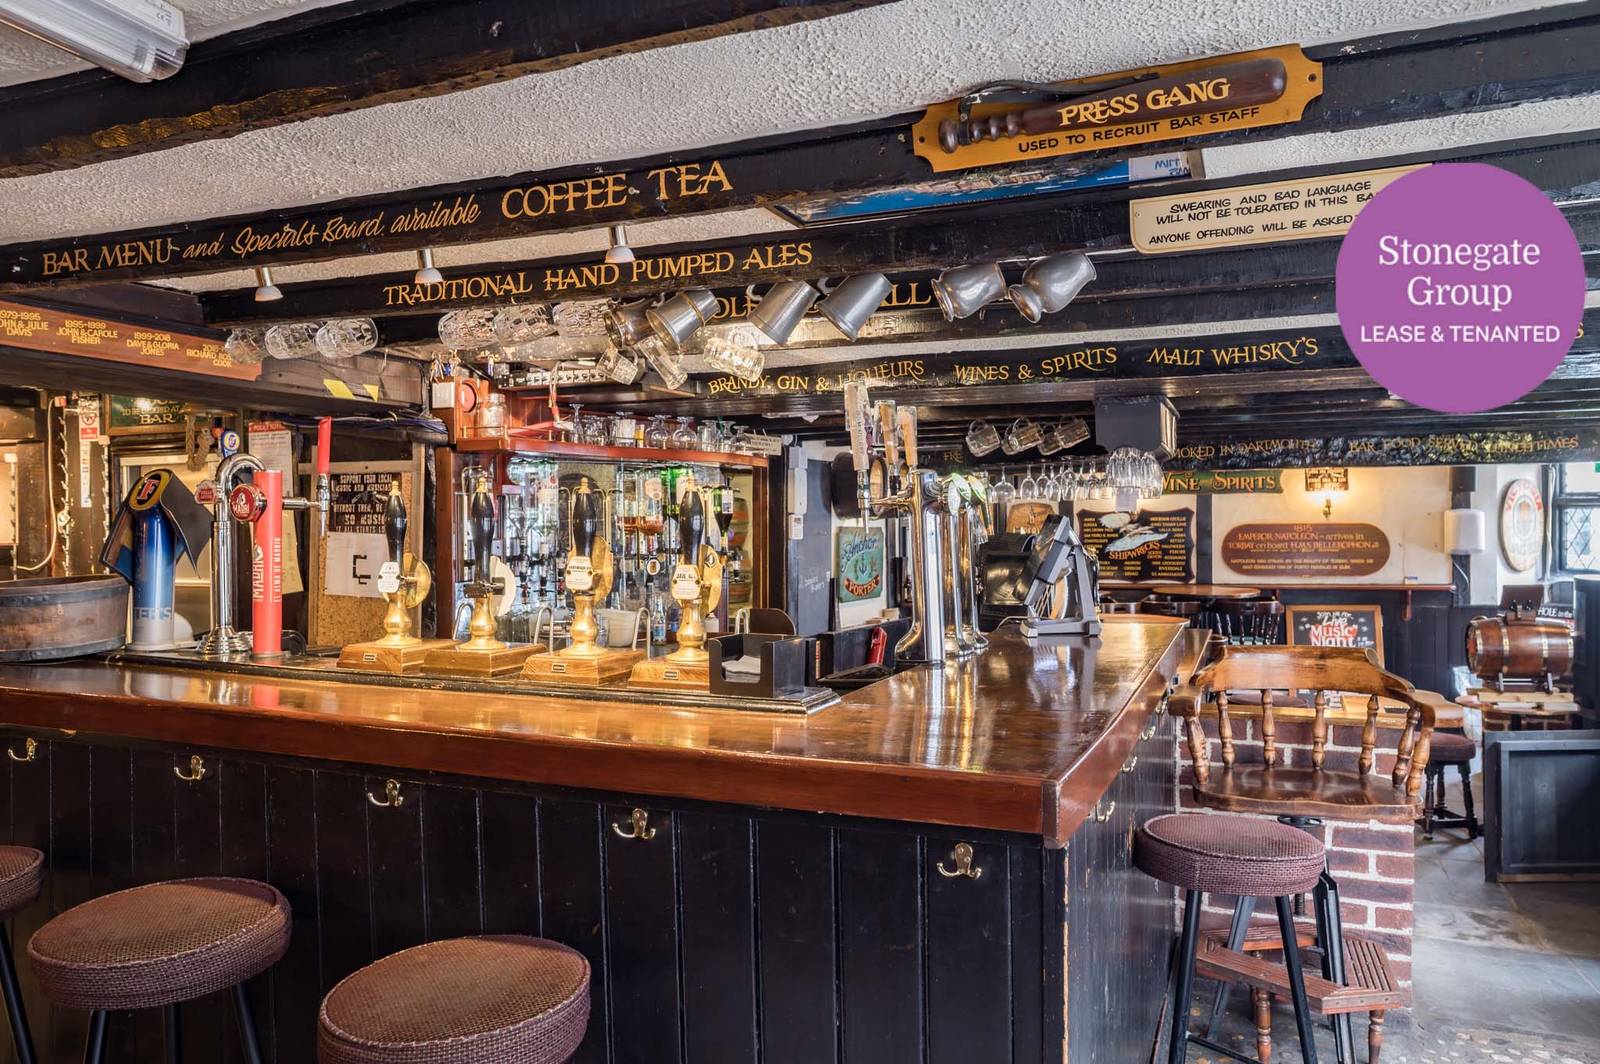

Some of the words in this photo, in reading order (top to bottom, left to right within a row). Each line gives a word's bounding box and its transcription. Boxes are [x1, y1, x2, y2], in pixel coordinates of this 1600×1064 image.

[1056, 93, 1139, 127] PRESS
[1145, 77, 1231, 110] GANG
[1018, 138, 1059, 153] USED
[1065, 134, 1086, 145] TO
[1093, 122, 1160, 141] RECRUIT
[1170, 116, 1202, 130] BAR
[1209, 107, 1260, 124] STAFF
[501, 173, 627, 219] COFFEE
[647, 160, 734, 200] TEA
[1169, 198, 1232, 214] SWEARING
[1239, 194, 1267, 205] AND
[1274, 190, 1301, 201] BAD
[1307, 181, 1372, 198] LANGUAGE
[1155, 213, 1183, 225] WILL
[1188, 210, 1212, 221] NOT
[1216, 208, 1232, 219] BE
[1233, 201, 1299, 216] TOLERATED
[1304, 198, 1317, 209] IN
[1320, 195, 1348, 207] THIS
[1356, 193, 1376, 202] BA
[42, 249, 91, 276] BAR
[95, 237, 174, 270] MENU
[182, 232, 225, 259] and
[231, 220, 319, 259] Specials
[321, 211, 384, 243] Board
[390, 193, 482, 234] available
[1148, 231, 1191, 245] ANYONE
[1196, 225, 1255, 240] OFFENDING
[1262, 221, 1287, 233] WILL
[1292, 219, 1307, 229] BE
[1312, 215, 1353, 228] ASKED
[382, 272, 533, 306] TRADITIONAL
[542, 263, 620, 292] HAND
[630, 251, 734, 282] PUMPED
[742, 242, 814, 271] ALES
[1147, 347, 1204, 366] MALT
[1210, 336, 1318, 366] WHISKY'S
[777, 375, 809, 391] GIN
[816, 377, 829, 391] &
[953, 364, 1009, 382] WINES
[1018, 364, 1035, 380] &
[1041, 346, 1118, 375] SPIRITS
[140, 414, 176, 424] BAR
[1220, 445, 1233, 456] IN
[1349, 441, 1376, 453] BAR
[1213, 471, 1277, 494] SPIRITS
[1108, 541, 1160, 560] SHIPWRECKS
[1238, 532, 1273, 541] EMPEROR
[1274, 532, 1319, 541] NAPOLEON
[849, 580, 876, 597] PORTER
[1538, 607, 1557, 617] HOLE
